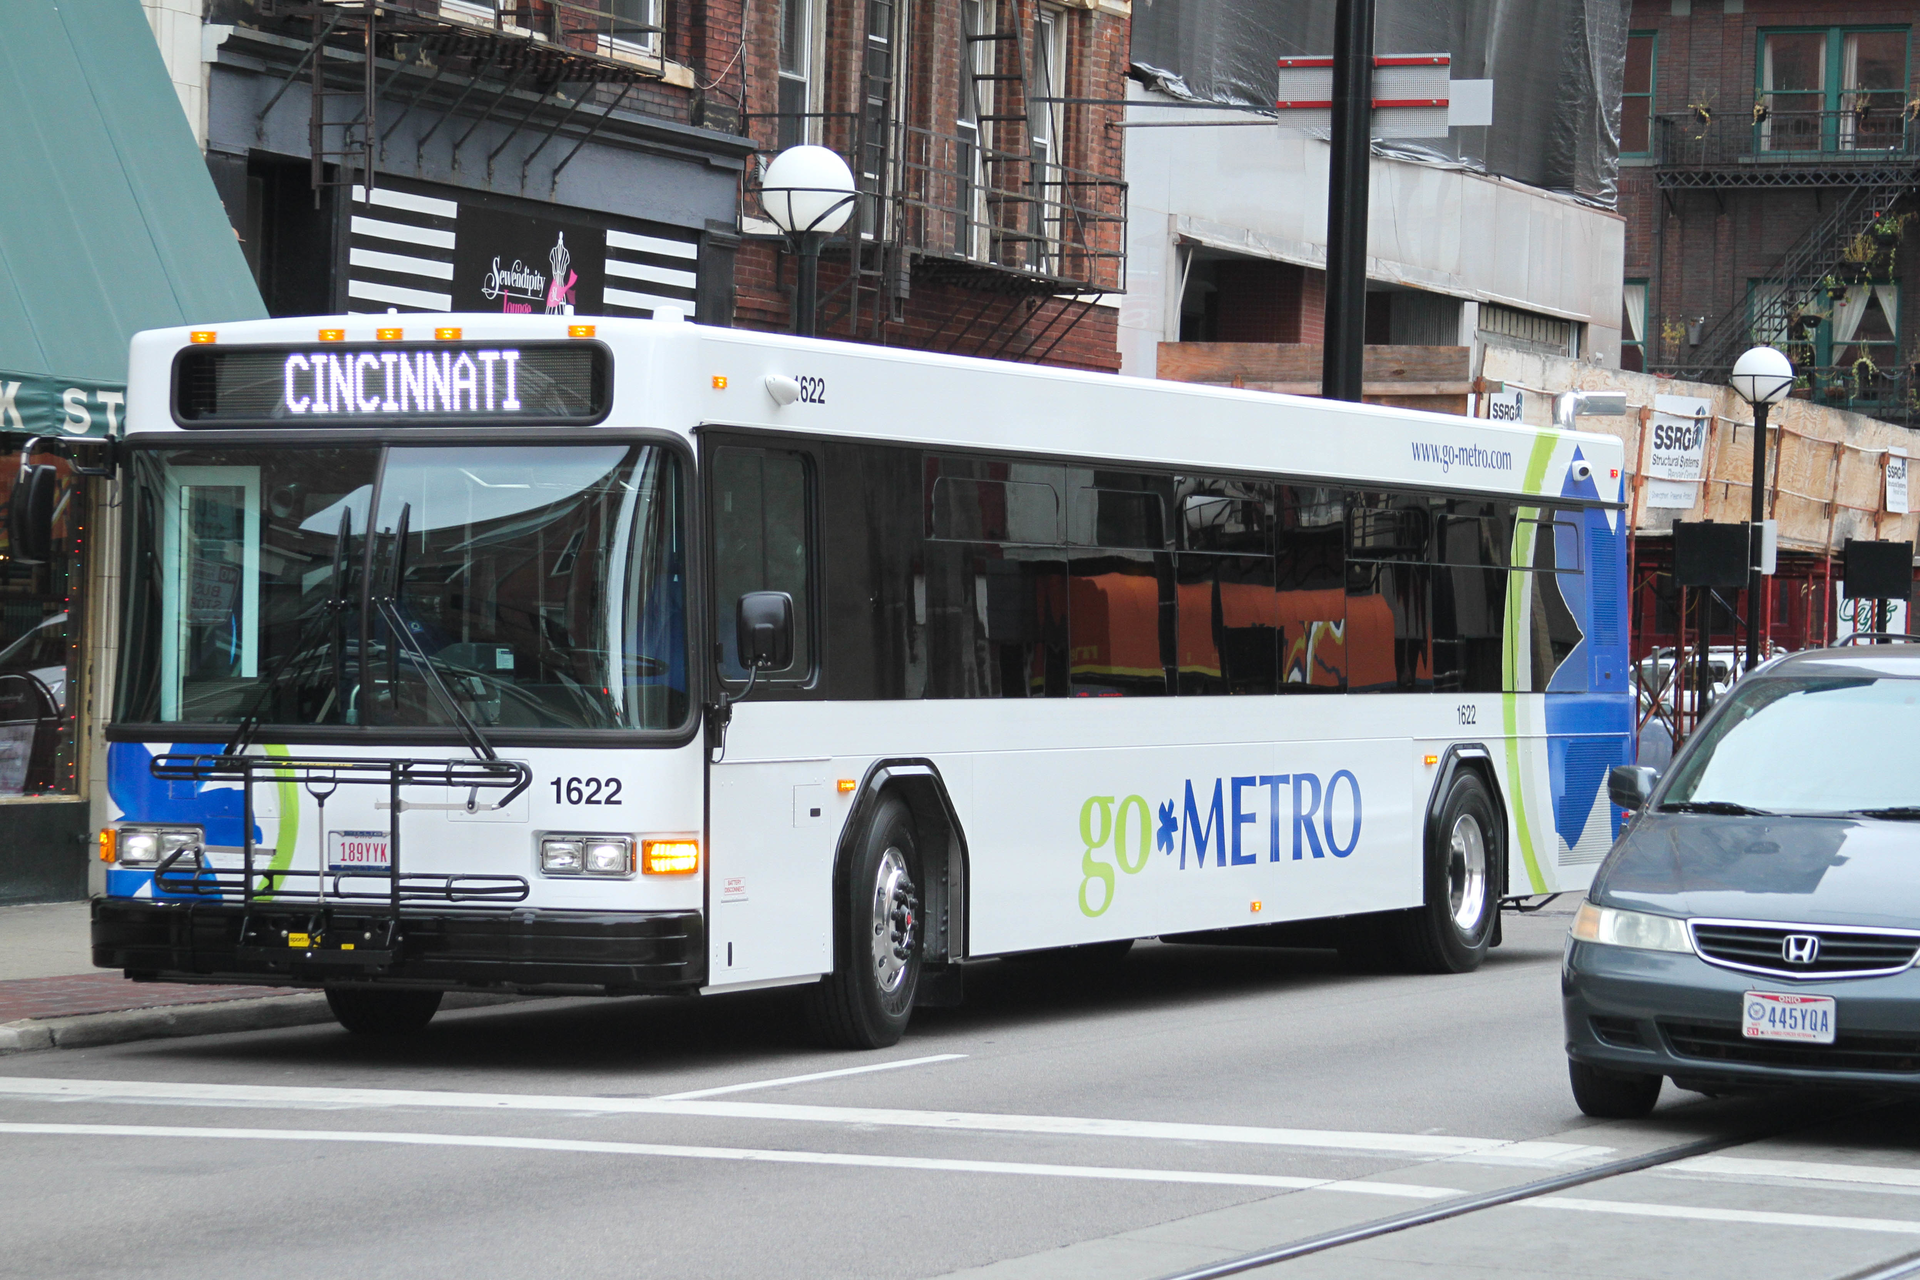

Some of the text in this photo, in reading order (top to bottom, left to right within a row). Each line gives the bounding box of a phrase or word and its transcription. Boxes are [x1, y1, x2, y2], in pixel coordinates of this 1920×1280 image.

[481, 255, 546, 299] Sewendipity
[284, 350, 521, 413] CINCINNATI
[1492, 402, 1516, 421] SSRG
[1653, 424, 1692, 452] SSRG
[1411, 442, 1512, 474] www.go-metro.com
[1457, 704, 1477, 726] 1622
[550, 777, 622, 805] 1622
[340, 842, 388, 862] 189YYK
[1778, 995, 1801, 1004] OHIO
[1768, 1006, 1829, 1032] 445YQA
